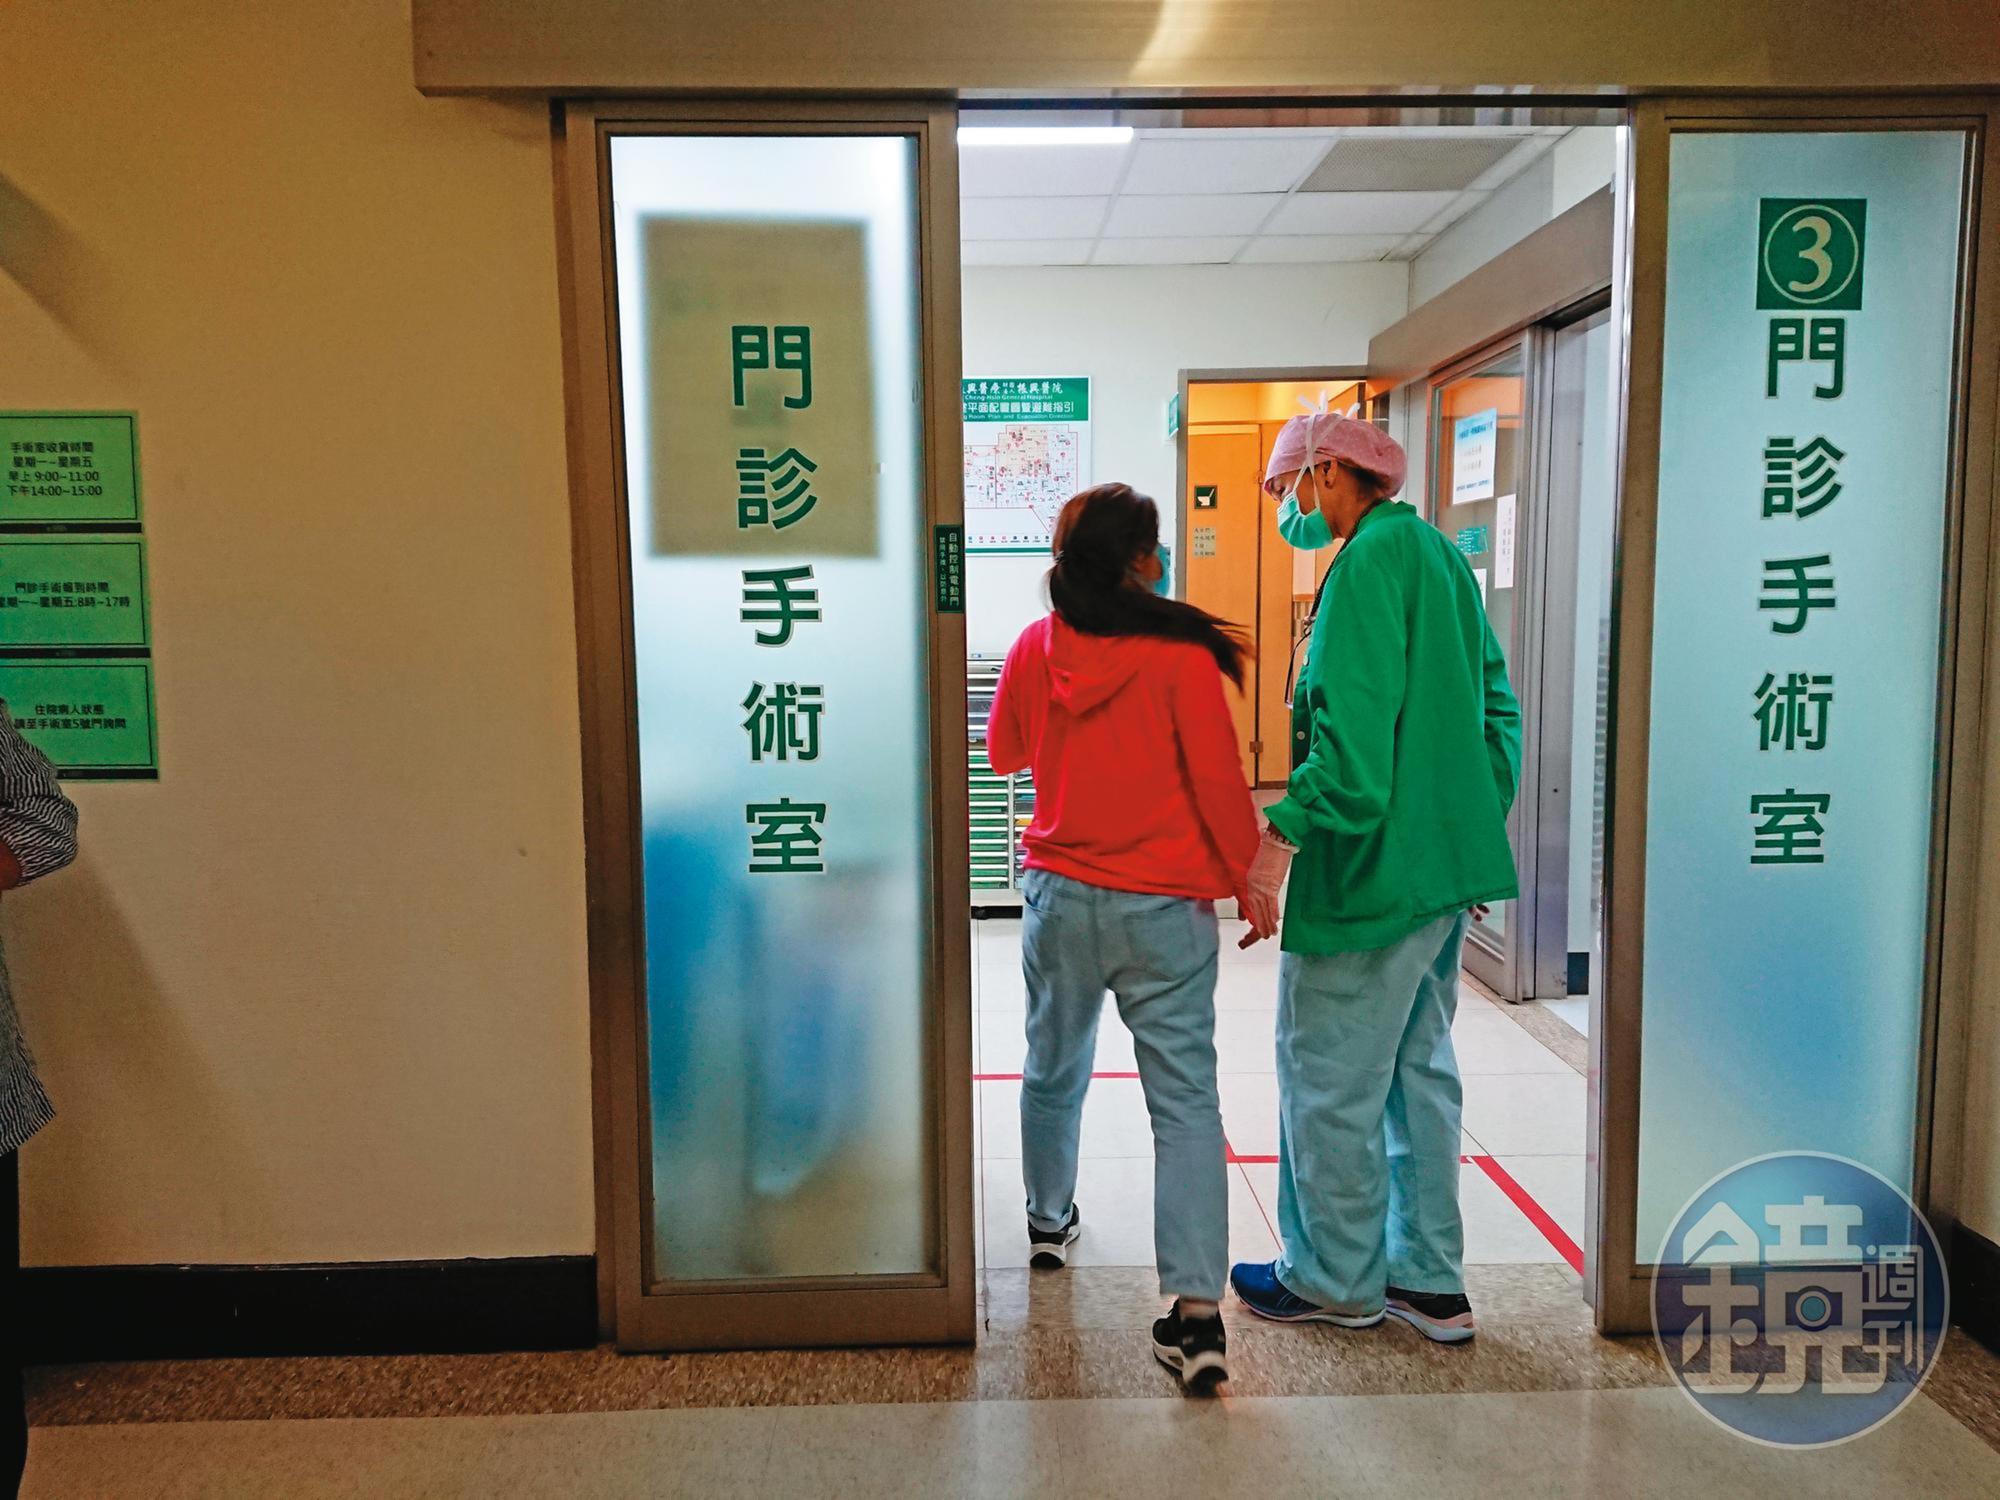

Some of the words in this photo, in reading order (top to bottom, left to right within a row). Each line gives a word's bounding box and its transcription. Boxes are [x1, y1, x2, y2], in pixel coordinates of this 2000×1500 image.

[1788, 215, 1833, 293] 3
[963, 381, 1063, 395] 興醫療財團法人振興醫院
[1026, 394, 1053, 402] Hospital
[731, 324, 827, 874] 門診手術室
[949, 532, 960, 607] 自動控制電動門
[1749, 317, 1847, 865] 門診手術室
